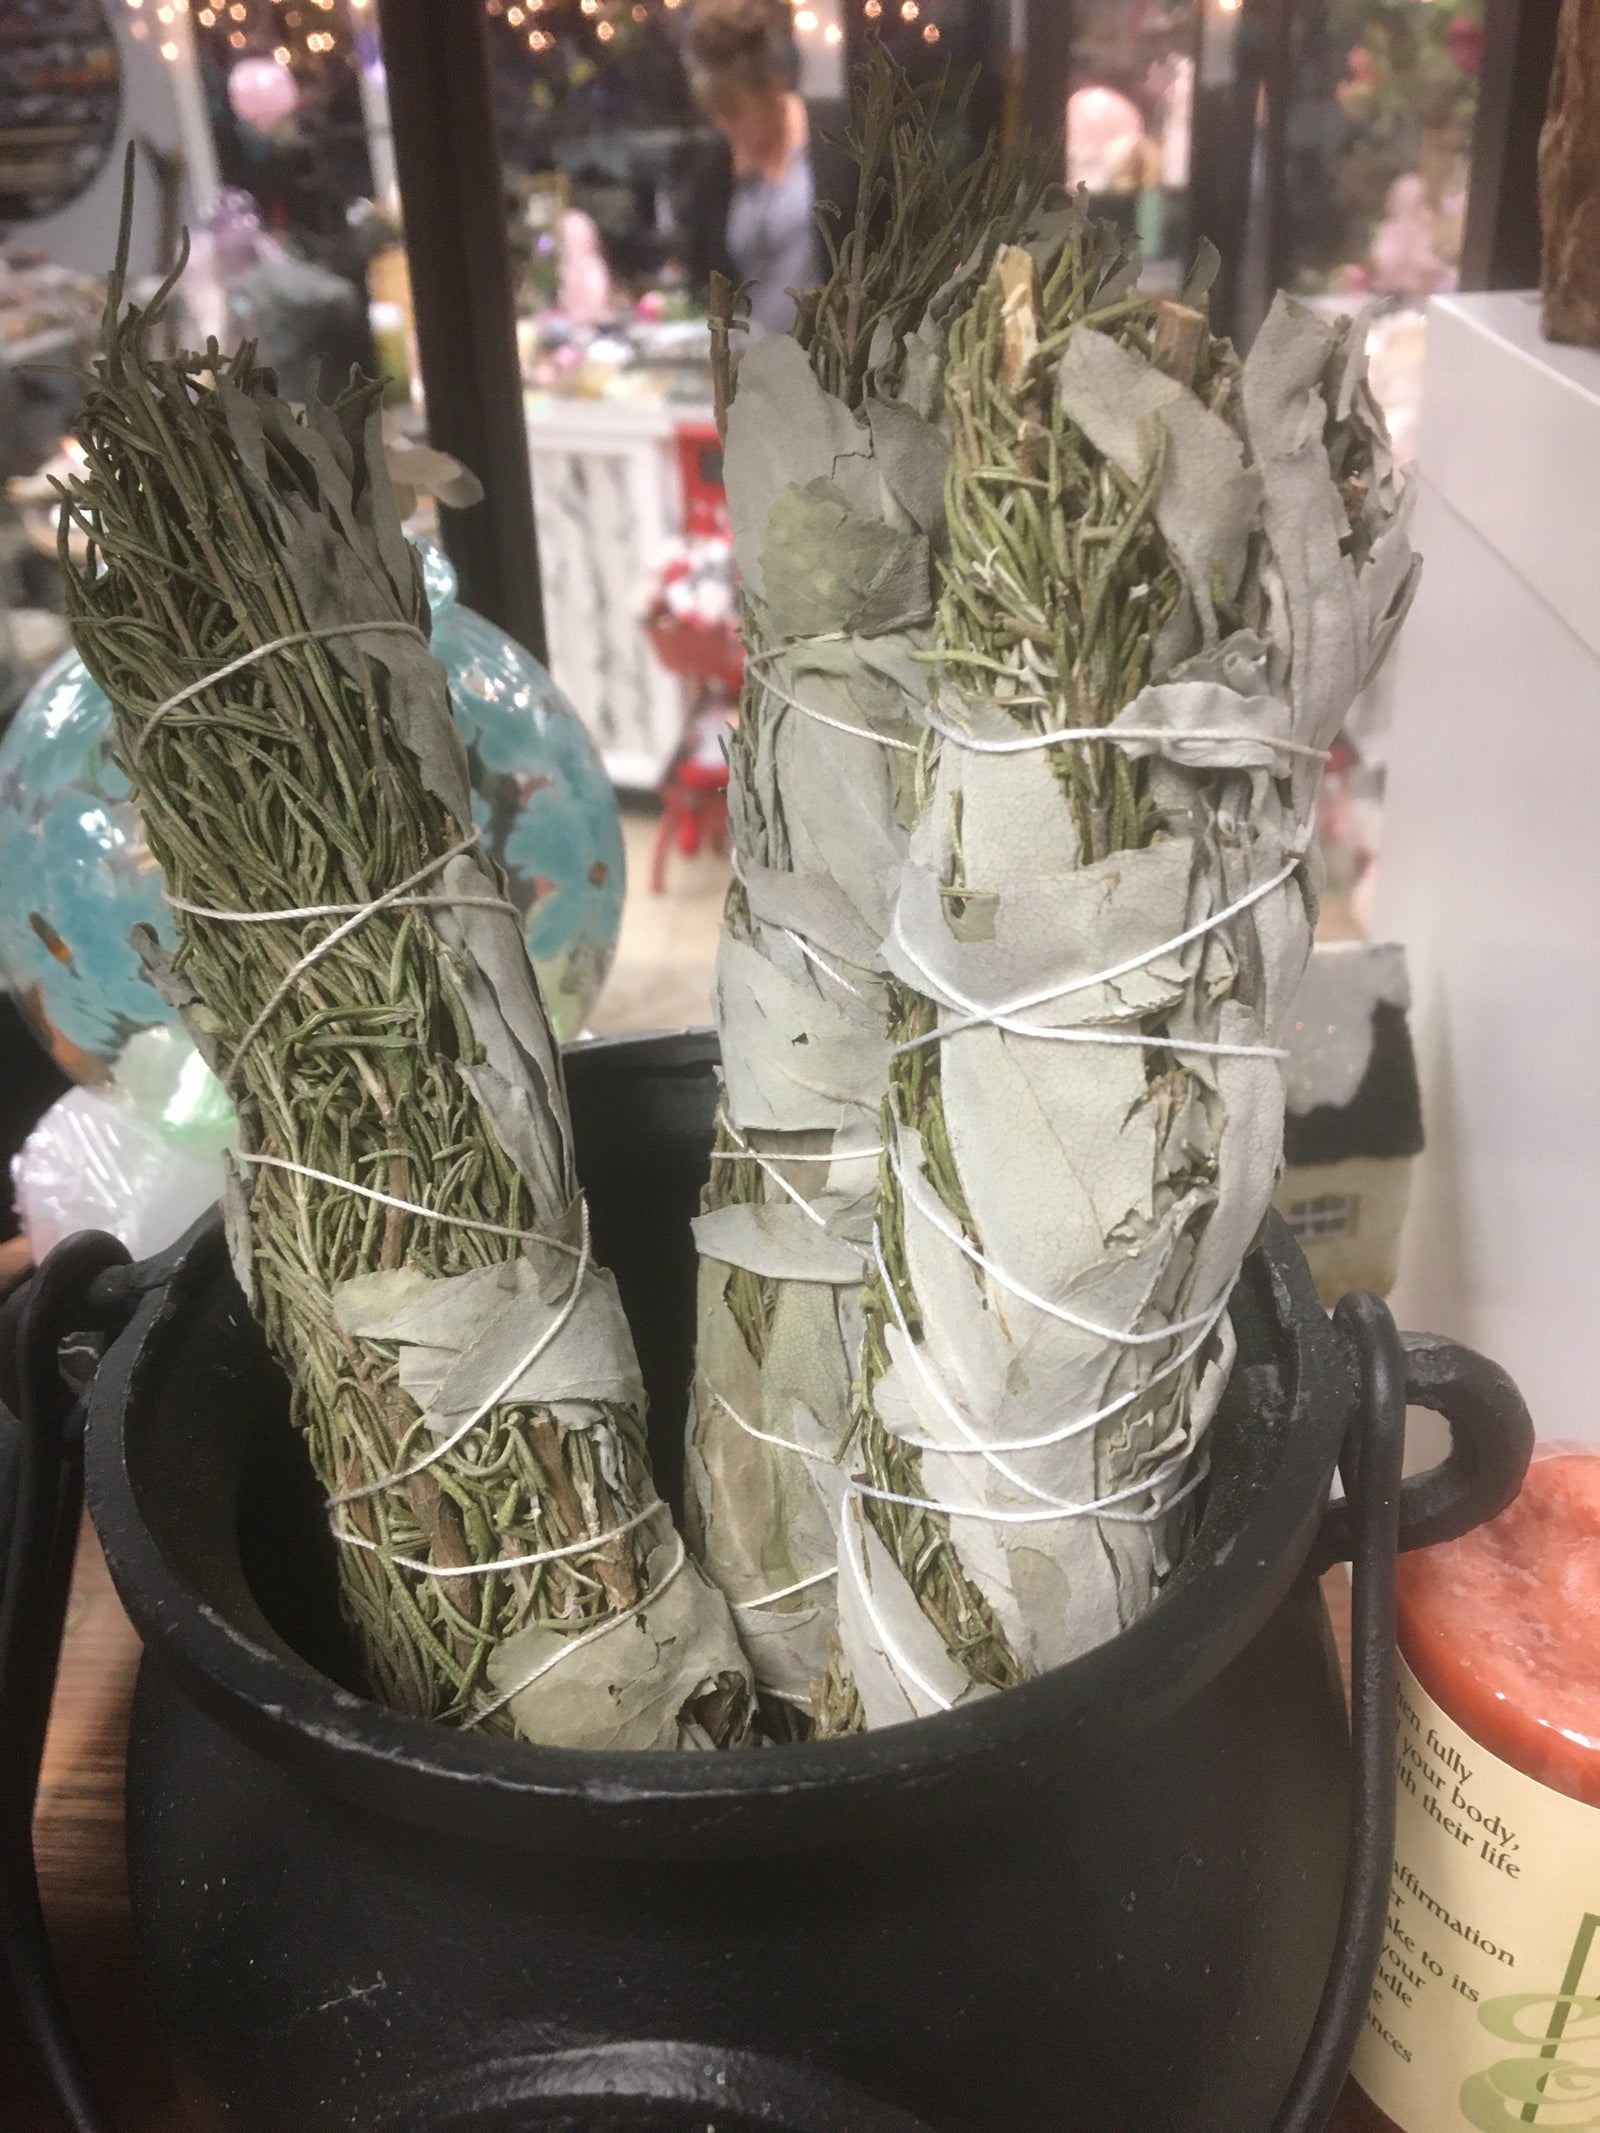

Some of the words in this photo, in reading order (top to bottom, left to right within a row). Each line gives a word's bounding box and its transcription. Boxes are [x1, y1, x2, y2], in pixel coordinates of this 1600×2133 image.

[1425, 1728, 1473, 1785] fully
[1402, 1736, 1446, 1790] your
[1451, 1785, 1520, 1851] body,
[1422, 1793, 1474, 1847] their
[1480, 1839, 1521, 1880] life
[1421, 1951, 1444, 1977] to
[1451, 1973, 1480, 2003] its
